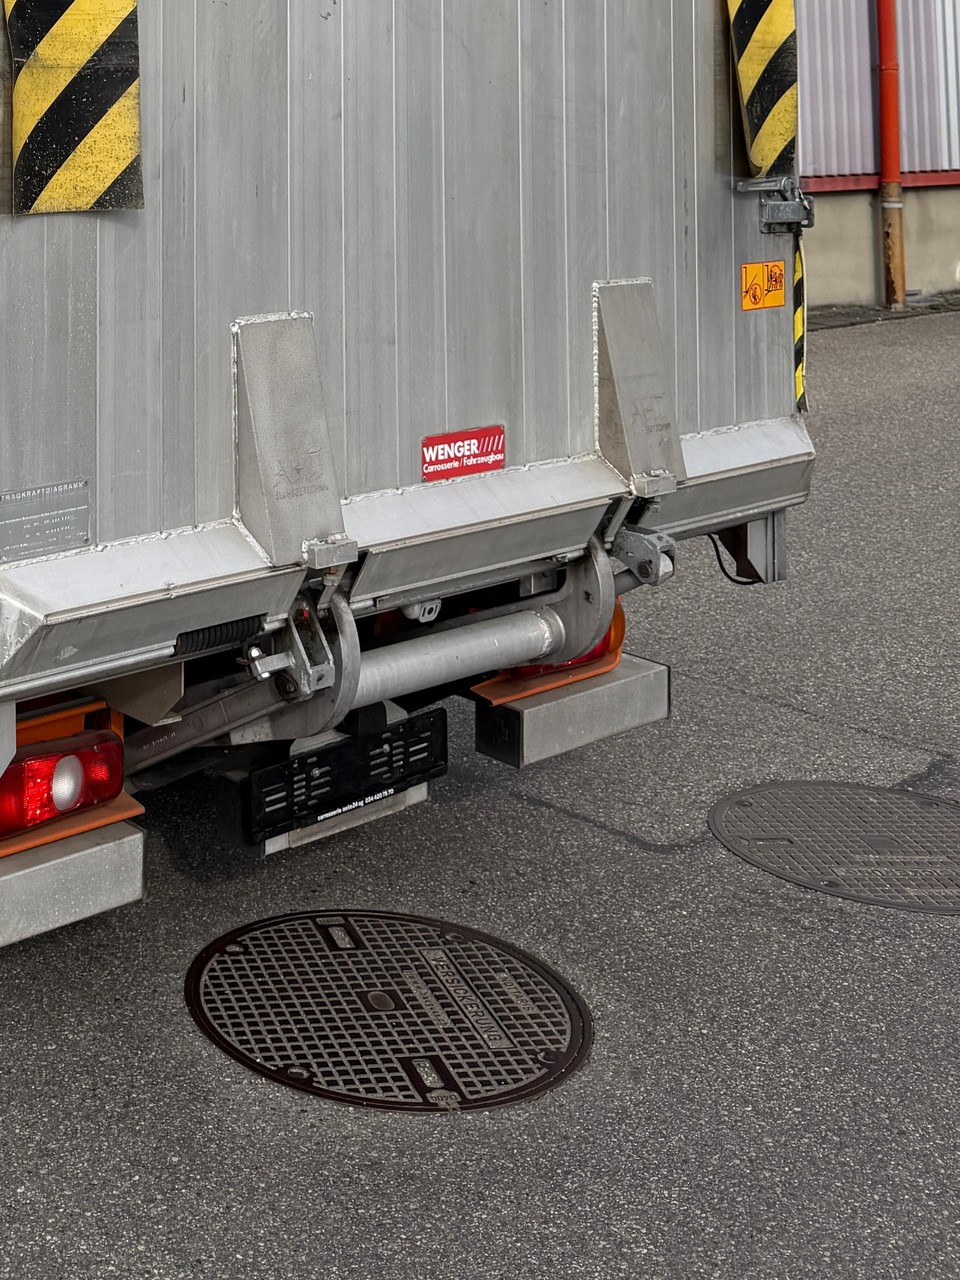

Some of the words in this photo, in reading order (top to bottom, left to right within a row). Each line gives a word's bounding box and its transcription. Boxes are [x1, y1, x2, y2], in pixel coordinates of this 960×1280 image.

[423, 439, 479, 462] WENGER
[423, 458, 459, 473] Carrosserie
[463, 452, 504, 467] Fahrzeugbau
[1, 481, 85, 501] TRAGKRAFTDIAGRAMM
[430, 956, 502, 1042] VERSICKERUNG
